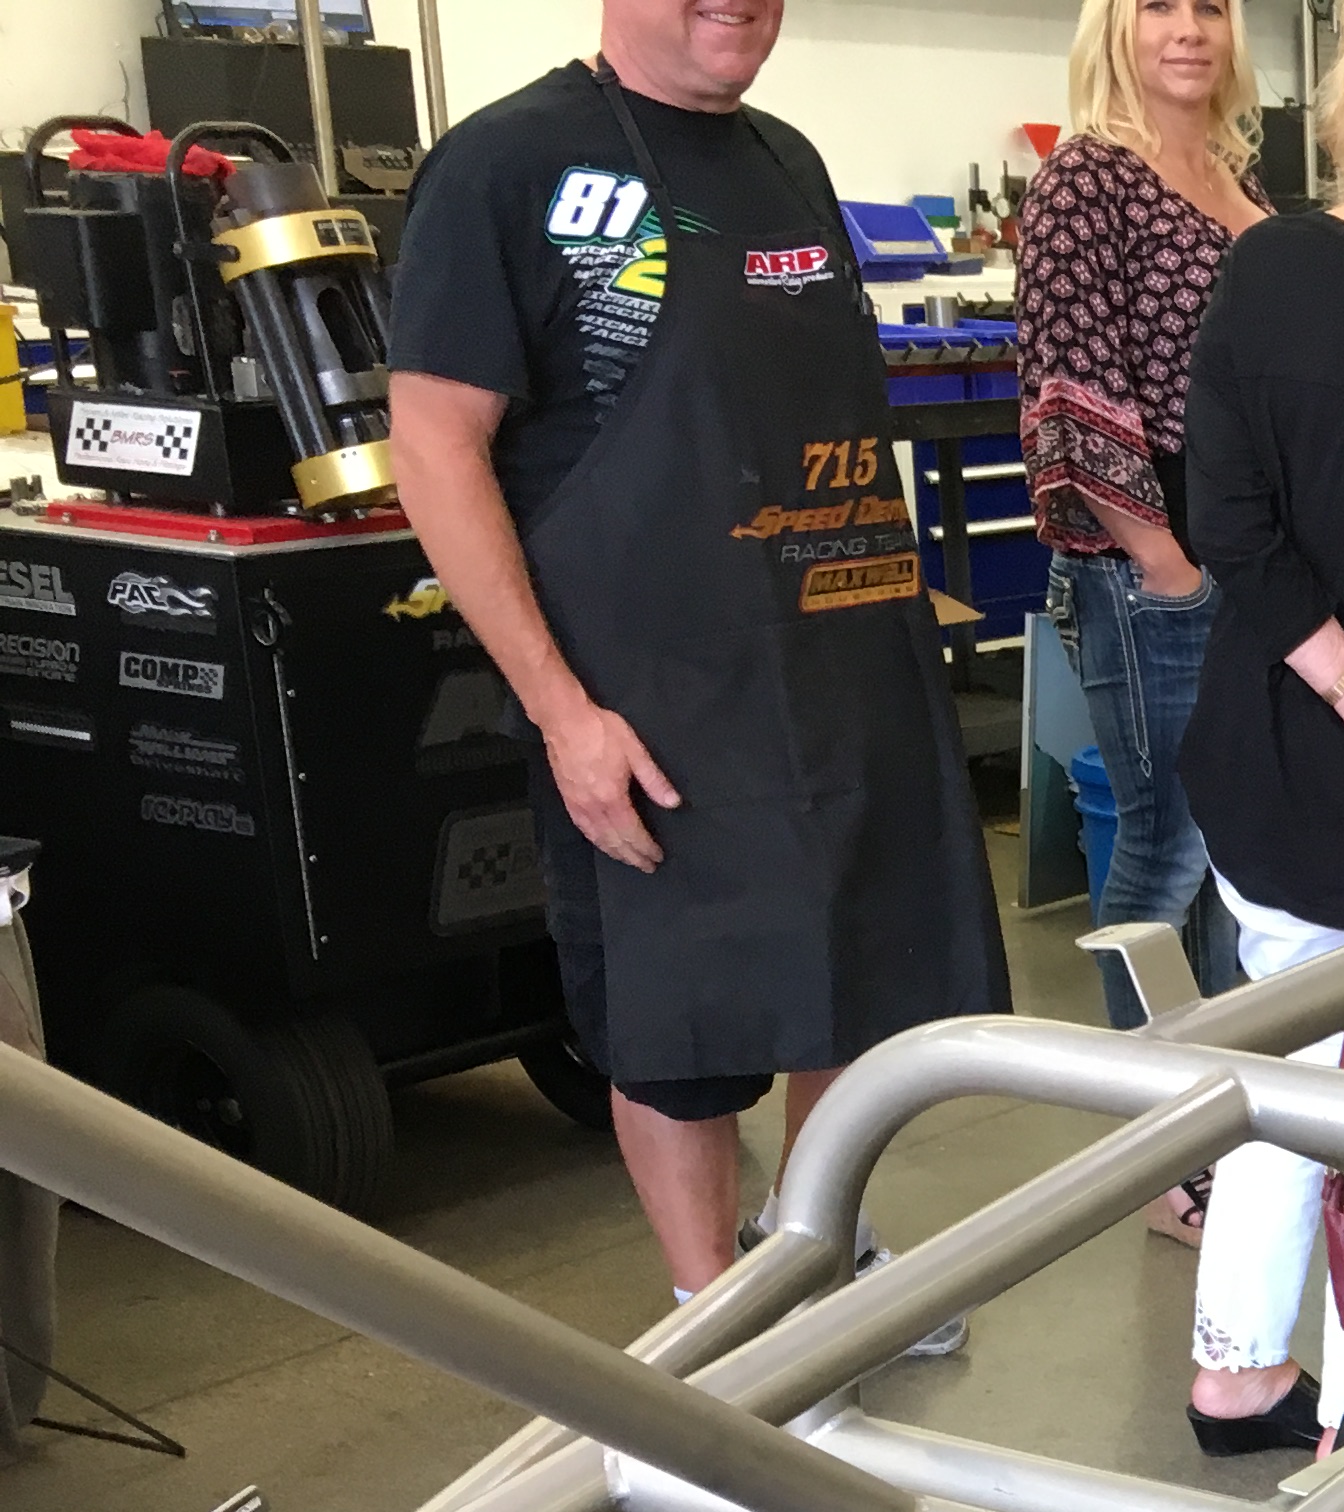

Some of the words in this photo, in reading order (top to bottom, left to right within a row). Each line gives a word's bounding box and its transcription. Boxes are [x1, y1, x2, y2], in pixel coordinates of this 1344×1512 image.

[547, 170, 649, 239] 81
[743, 247, 828, 276] ARP
[110, 429, 154, 446] BMRS
[803, 437, 878, 490] 715
[808, 560, 914, 597] MAXWELL
[108, 580, 169, 610] PAC
[124, 656, 199, 684] COMP
